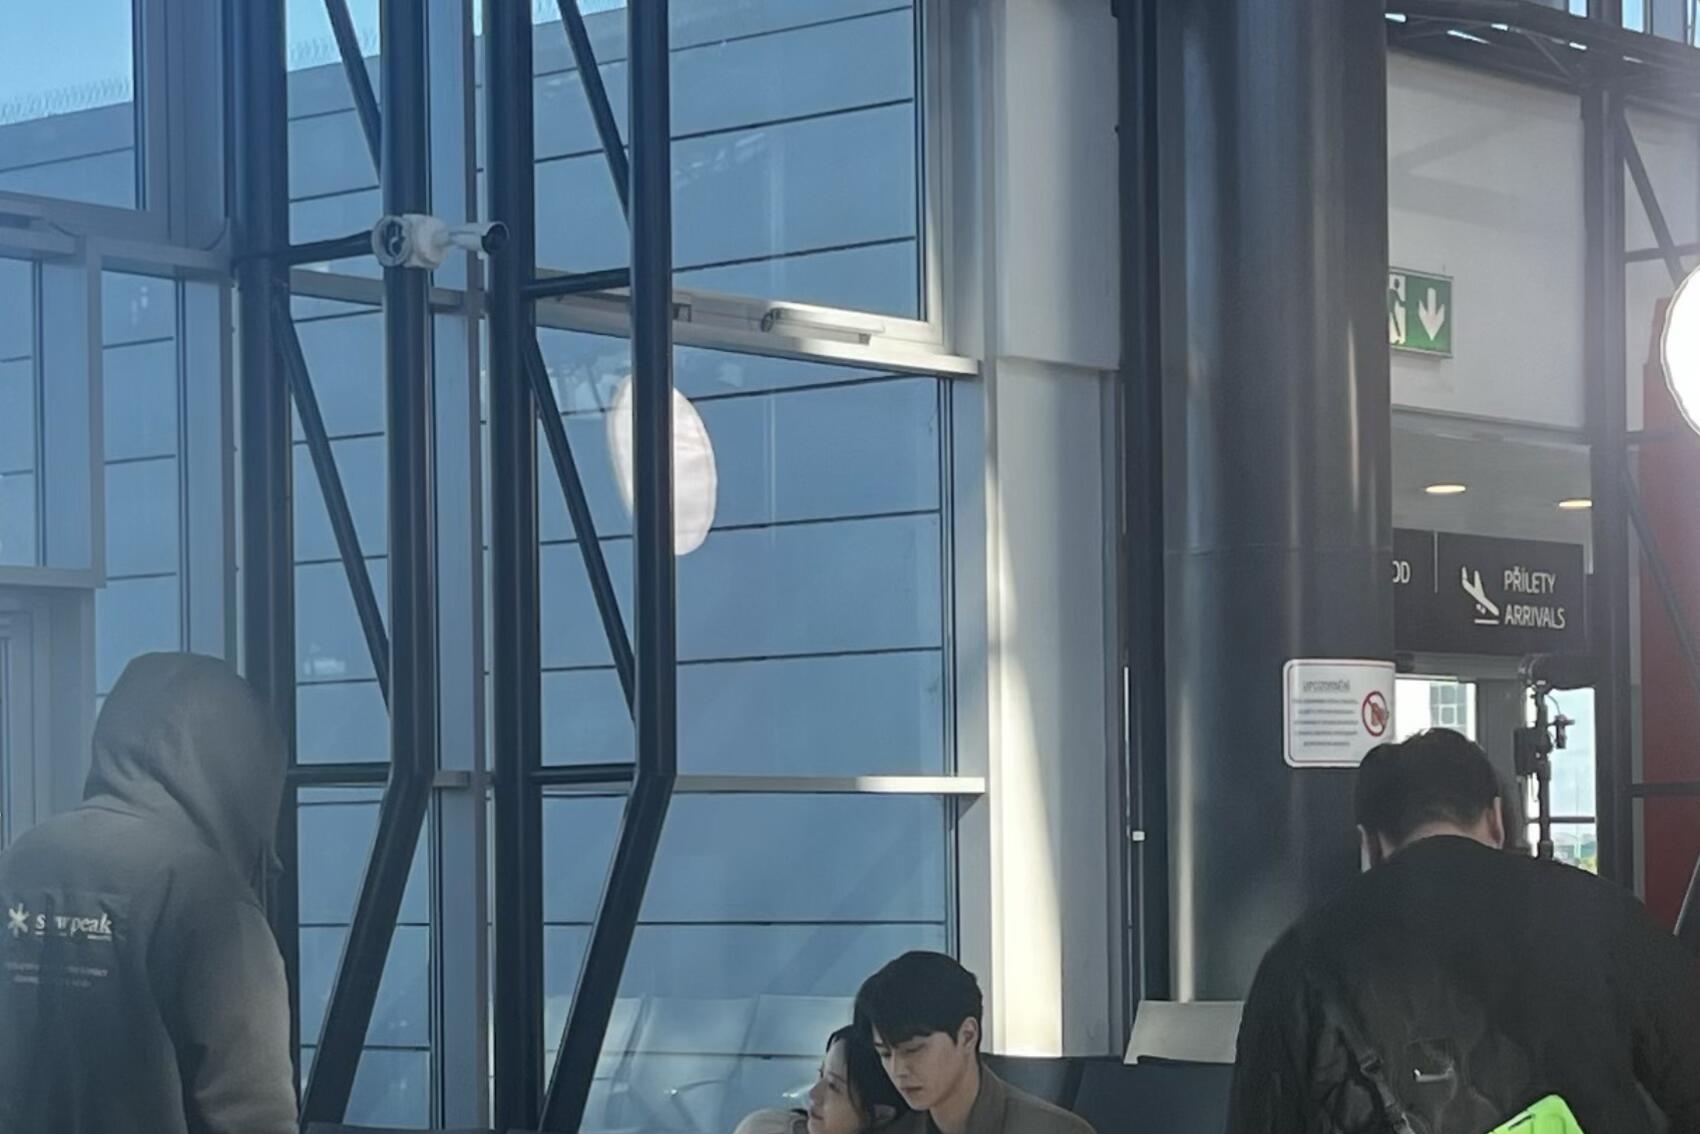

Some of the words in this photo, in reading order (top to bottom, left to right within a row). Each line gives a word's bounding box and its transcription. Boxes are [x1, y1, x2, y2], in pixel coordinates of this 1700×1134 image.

[1504, 566, 1556, 594] PŘÍLETY
[1504, 604, 1566, 629] ARRIVALS
[70, 913, 113, 937] peak
